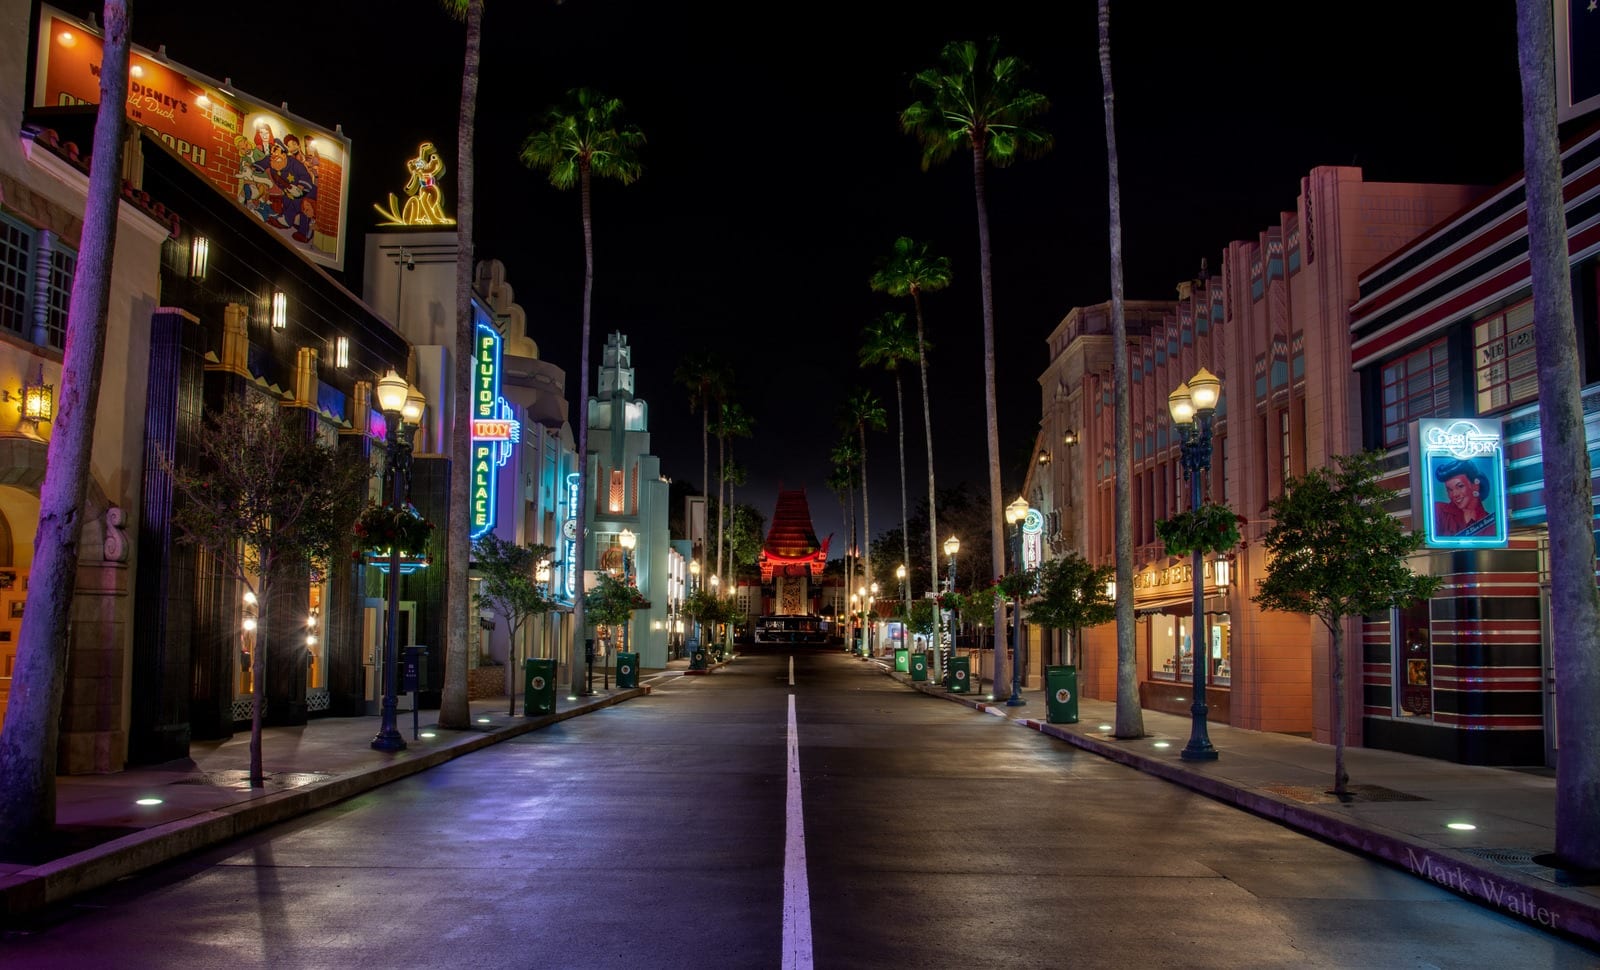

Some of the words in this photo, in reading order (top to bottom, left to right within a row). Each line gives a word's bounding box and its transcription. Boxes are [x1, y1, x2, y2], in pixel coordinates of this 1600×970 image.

[132, 82, 188, 113] DISNEY'S
[144, 97, 175, 124] Duck
[132, 110, 142, 118] IN
[475, 423, 509, 437] TOY
[475, 447, 489, 526] PALACE
